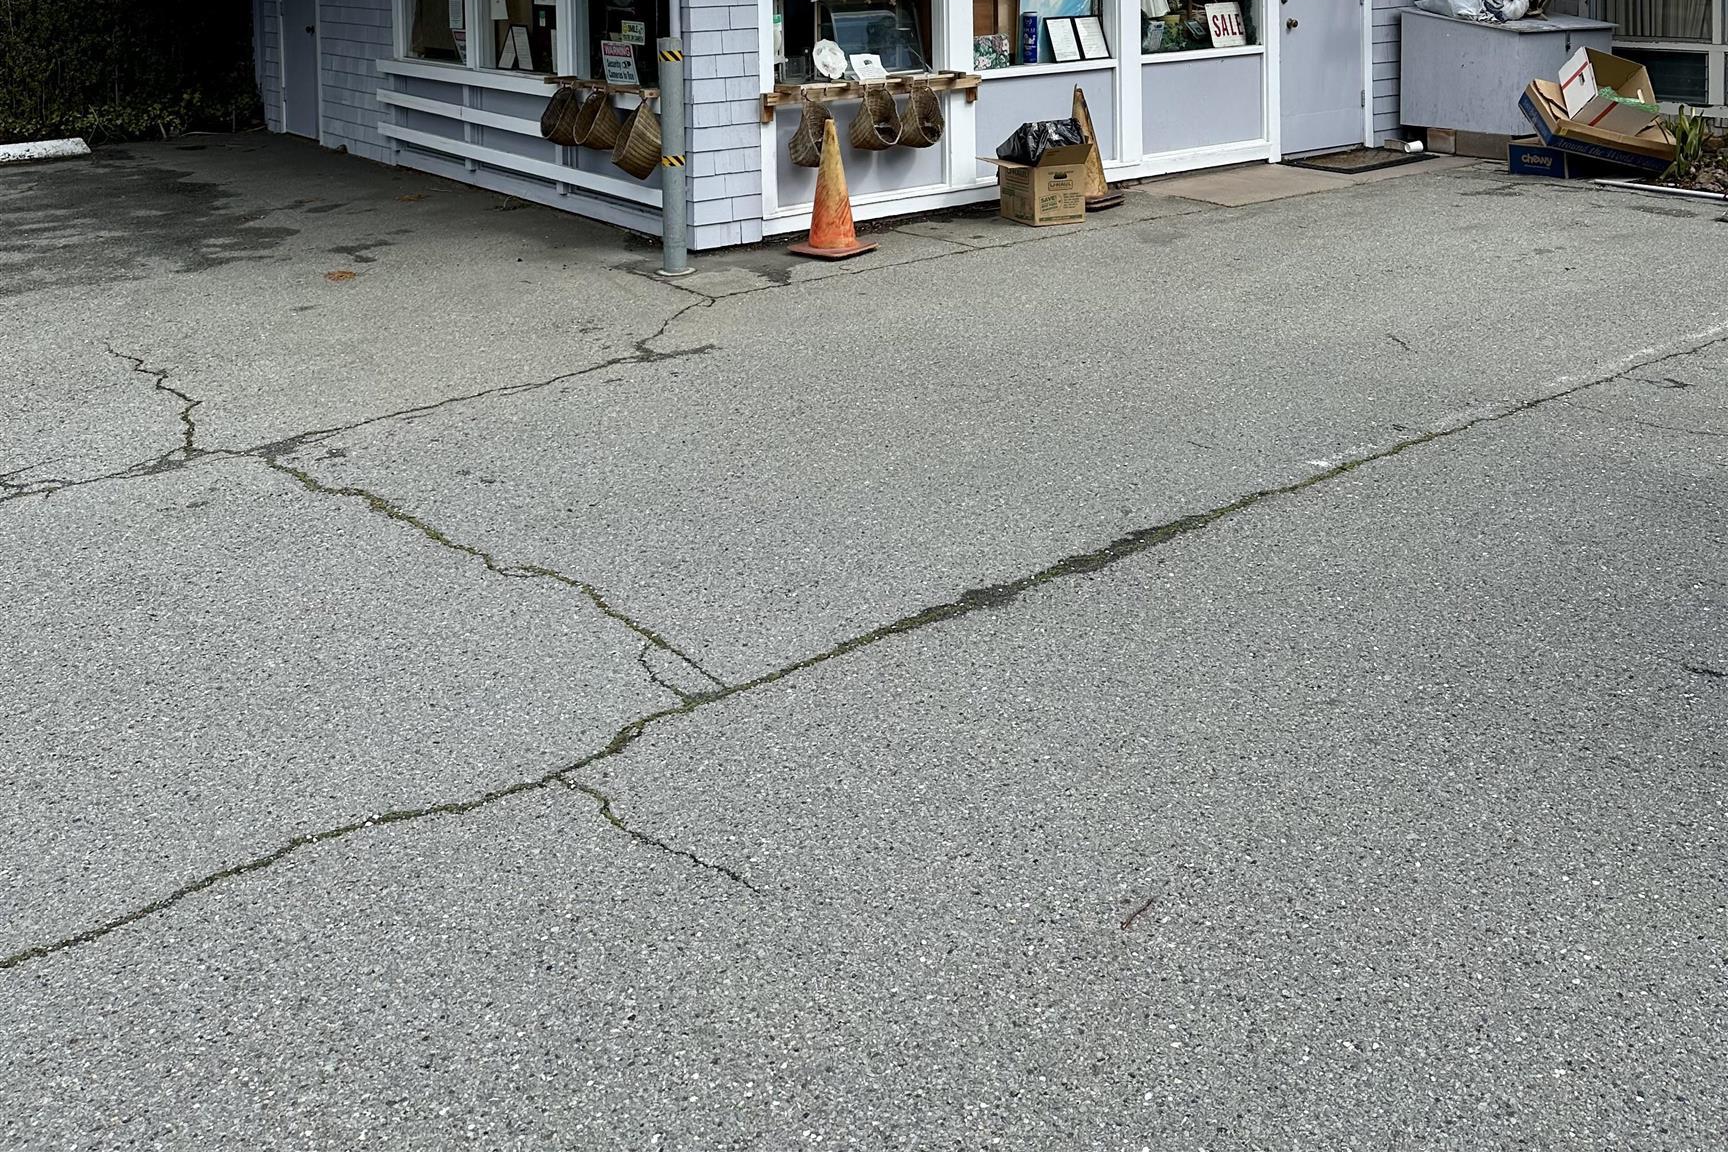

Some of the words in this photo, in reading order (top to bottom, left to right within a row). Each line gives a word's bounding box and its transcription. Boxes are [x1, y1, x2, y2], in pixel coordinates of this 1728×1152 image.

[1212, 13, 1244, 37] SALE
[604, 44, 632, 56] WARNING
[1521, 152, 1553, 167] chewy
